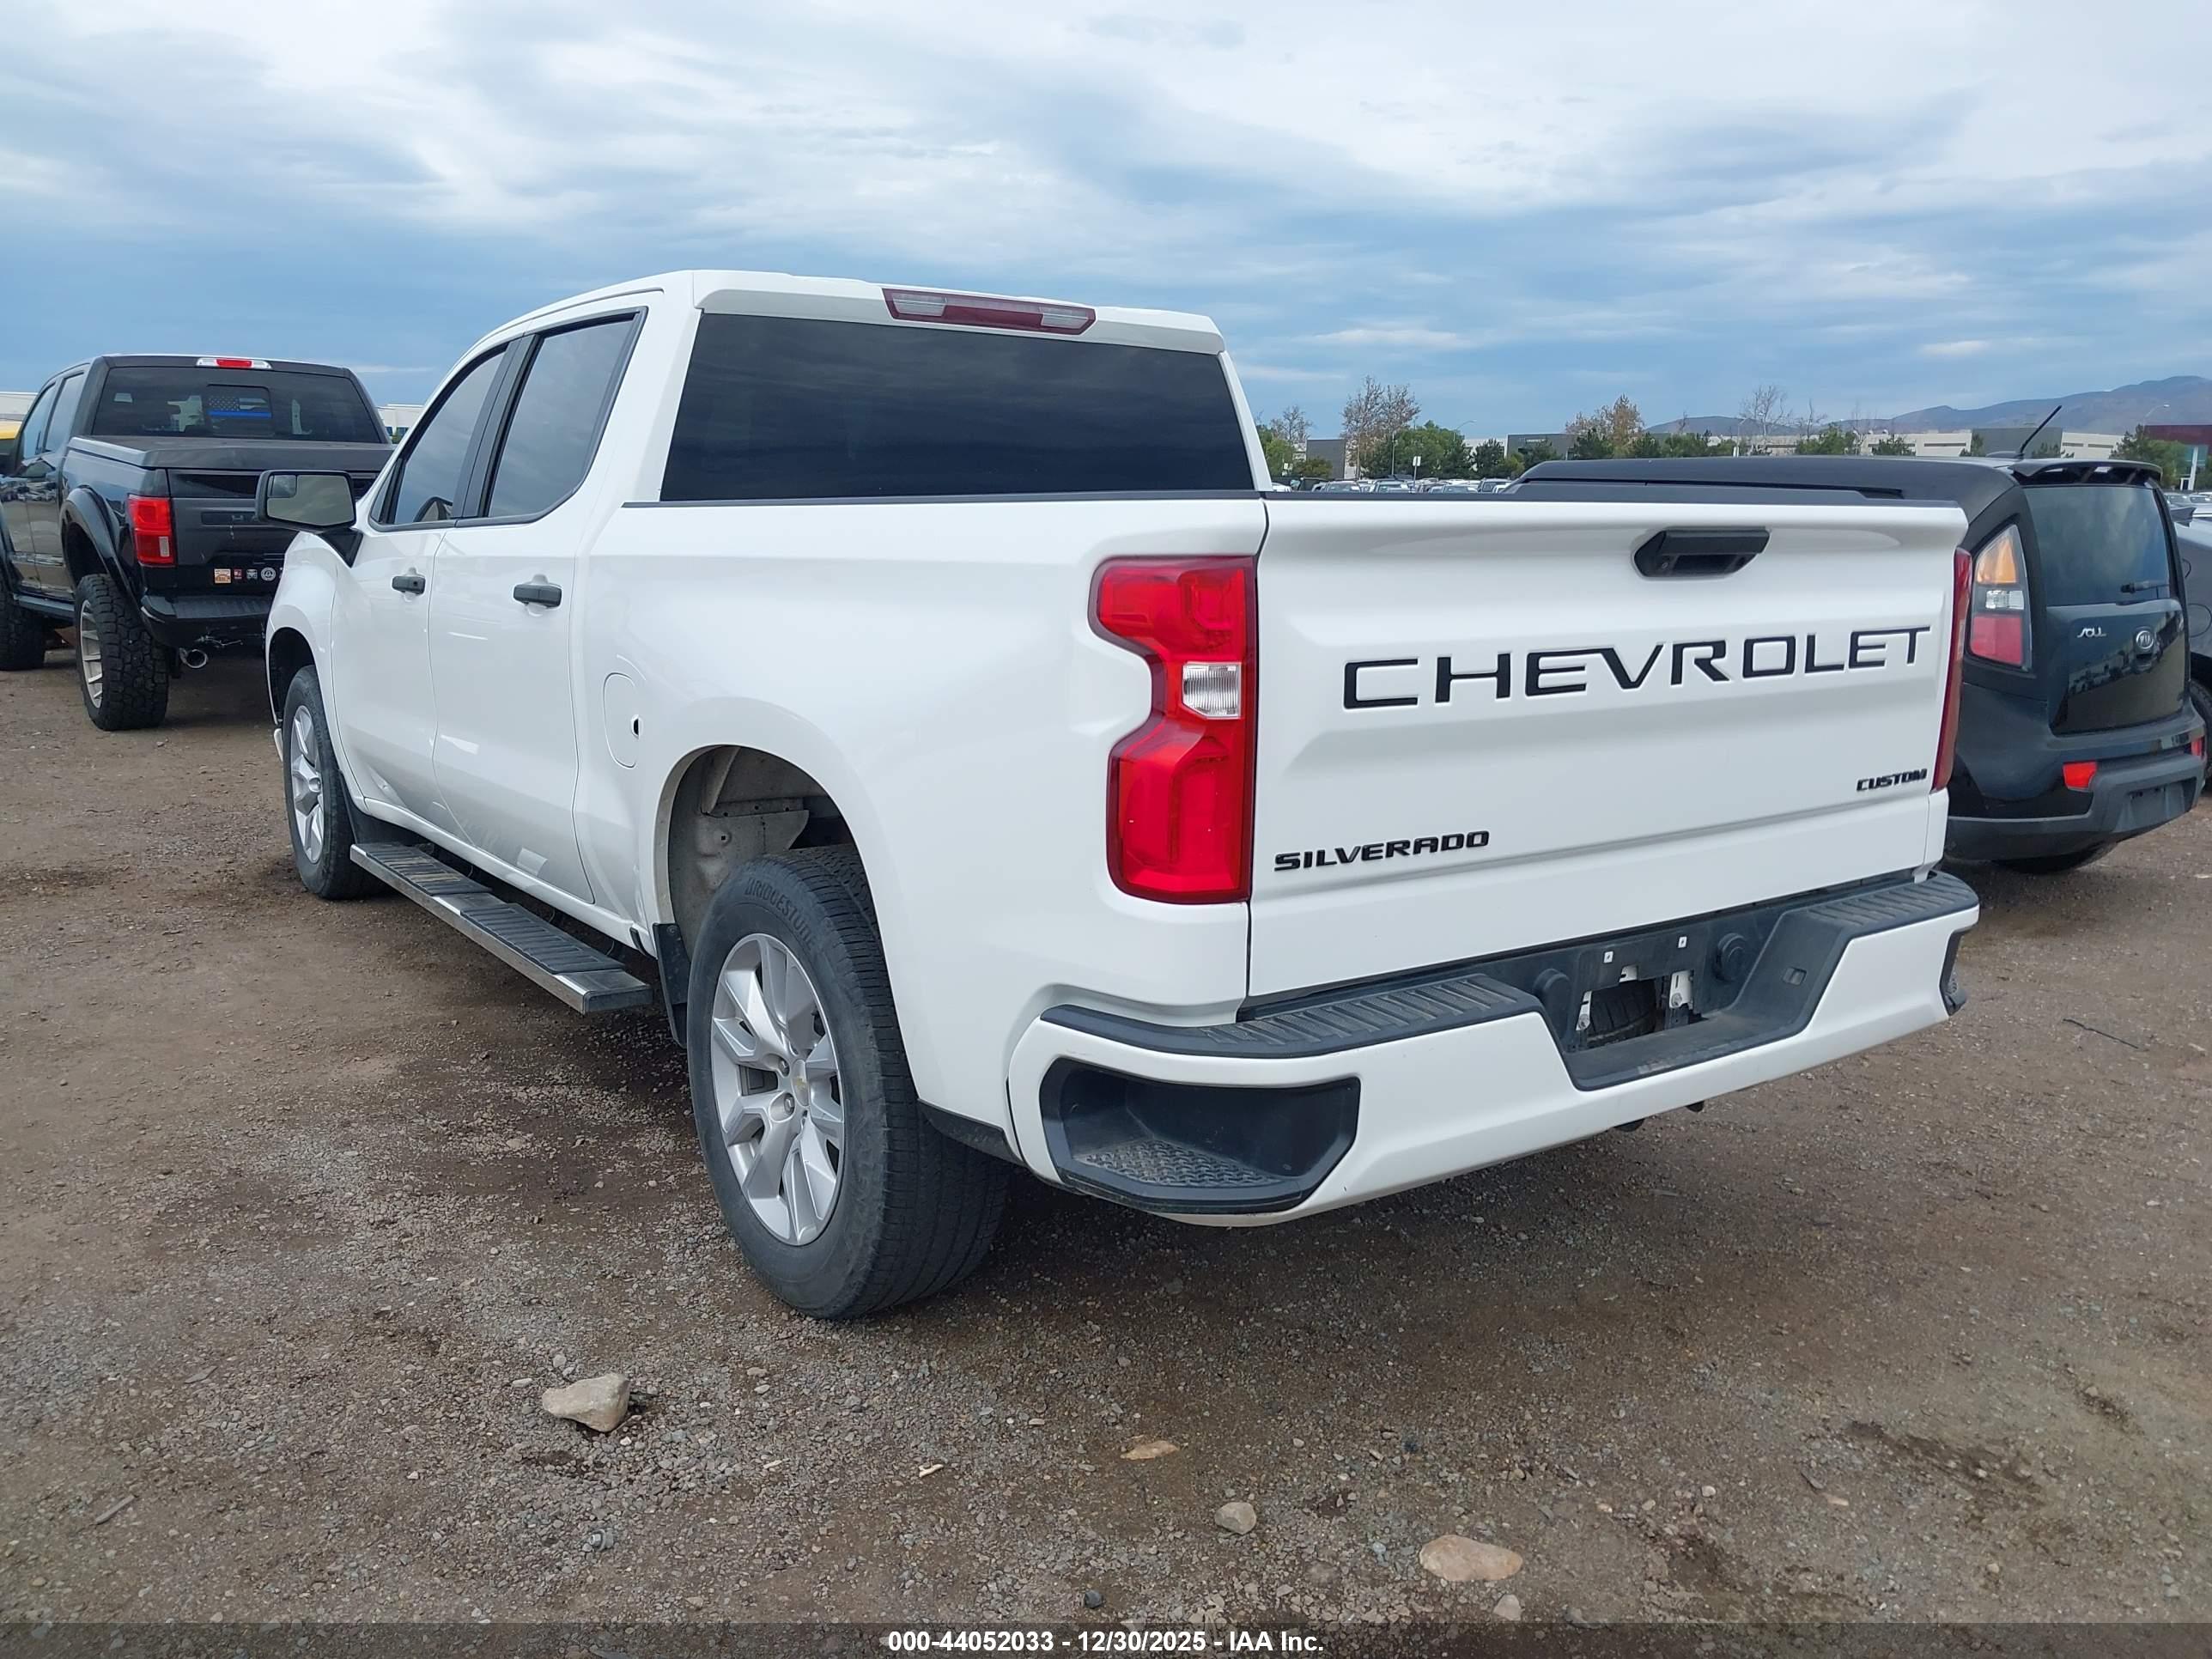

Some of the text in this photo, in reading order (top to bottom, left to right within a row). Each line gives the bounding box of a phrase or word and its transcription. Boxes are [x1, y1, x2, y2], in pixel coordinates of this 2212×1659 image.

[1343, 626, 1931, 709] CHEVROLET
[1856, 769, 1929, 792] CUSTOM
[1274, 830, 1491, 872] SILVERADO
